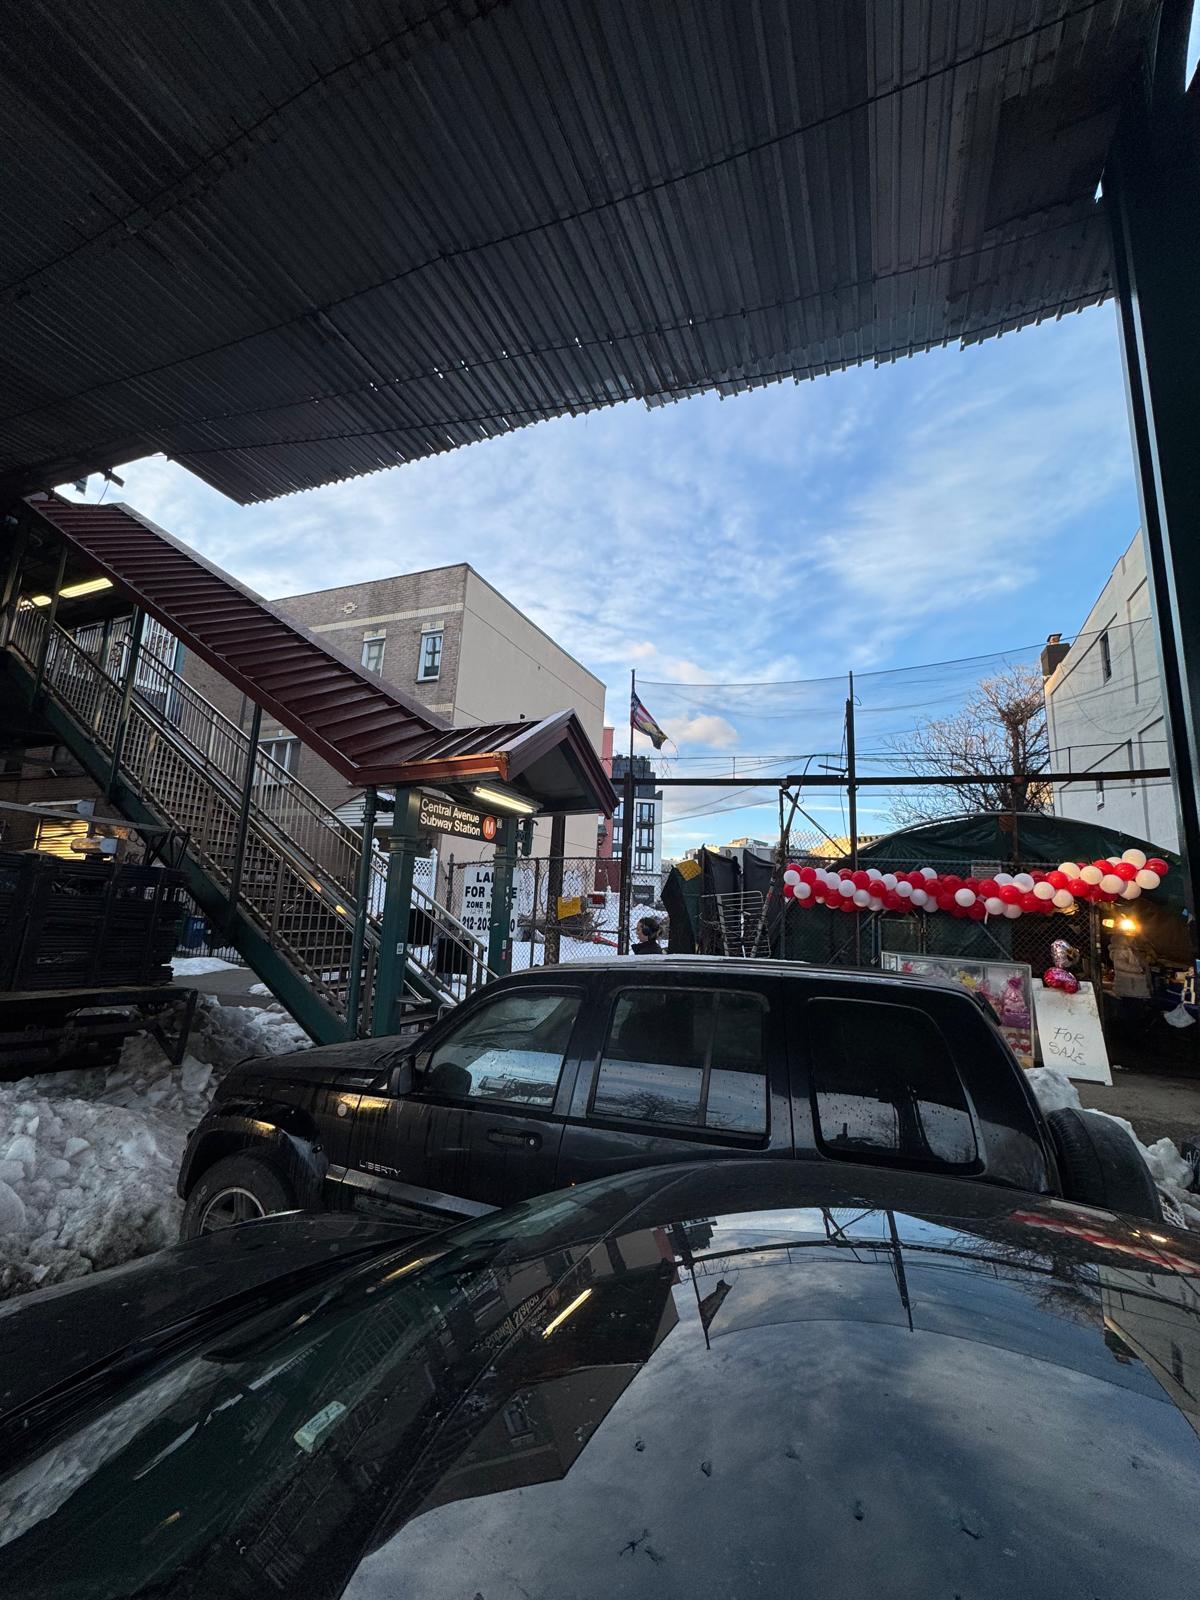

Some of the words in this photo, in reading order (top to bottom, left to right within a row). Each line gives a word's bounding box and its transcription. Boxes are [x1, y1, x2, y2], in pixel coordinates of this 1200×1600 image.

[421, 798, 452, 817] Central
[453, 807, 480, 824] Avenue
[420, 812, 453, 832] Subway
[454, 820, 481, 836] Station
[485, 820, 495, 835] M
[465, 886, 485, 898] FOR
[466, 901, 483, 909] ZONE
[1053, 1026, 1085, 1047] FOR
[1048, 1041, 1087, 1066] SALE
[359, 1159, 401, 1176] LIBERTY
